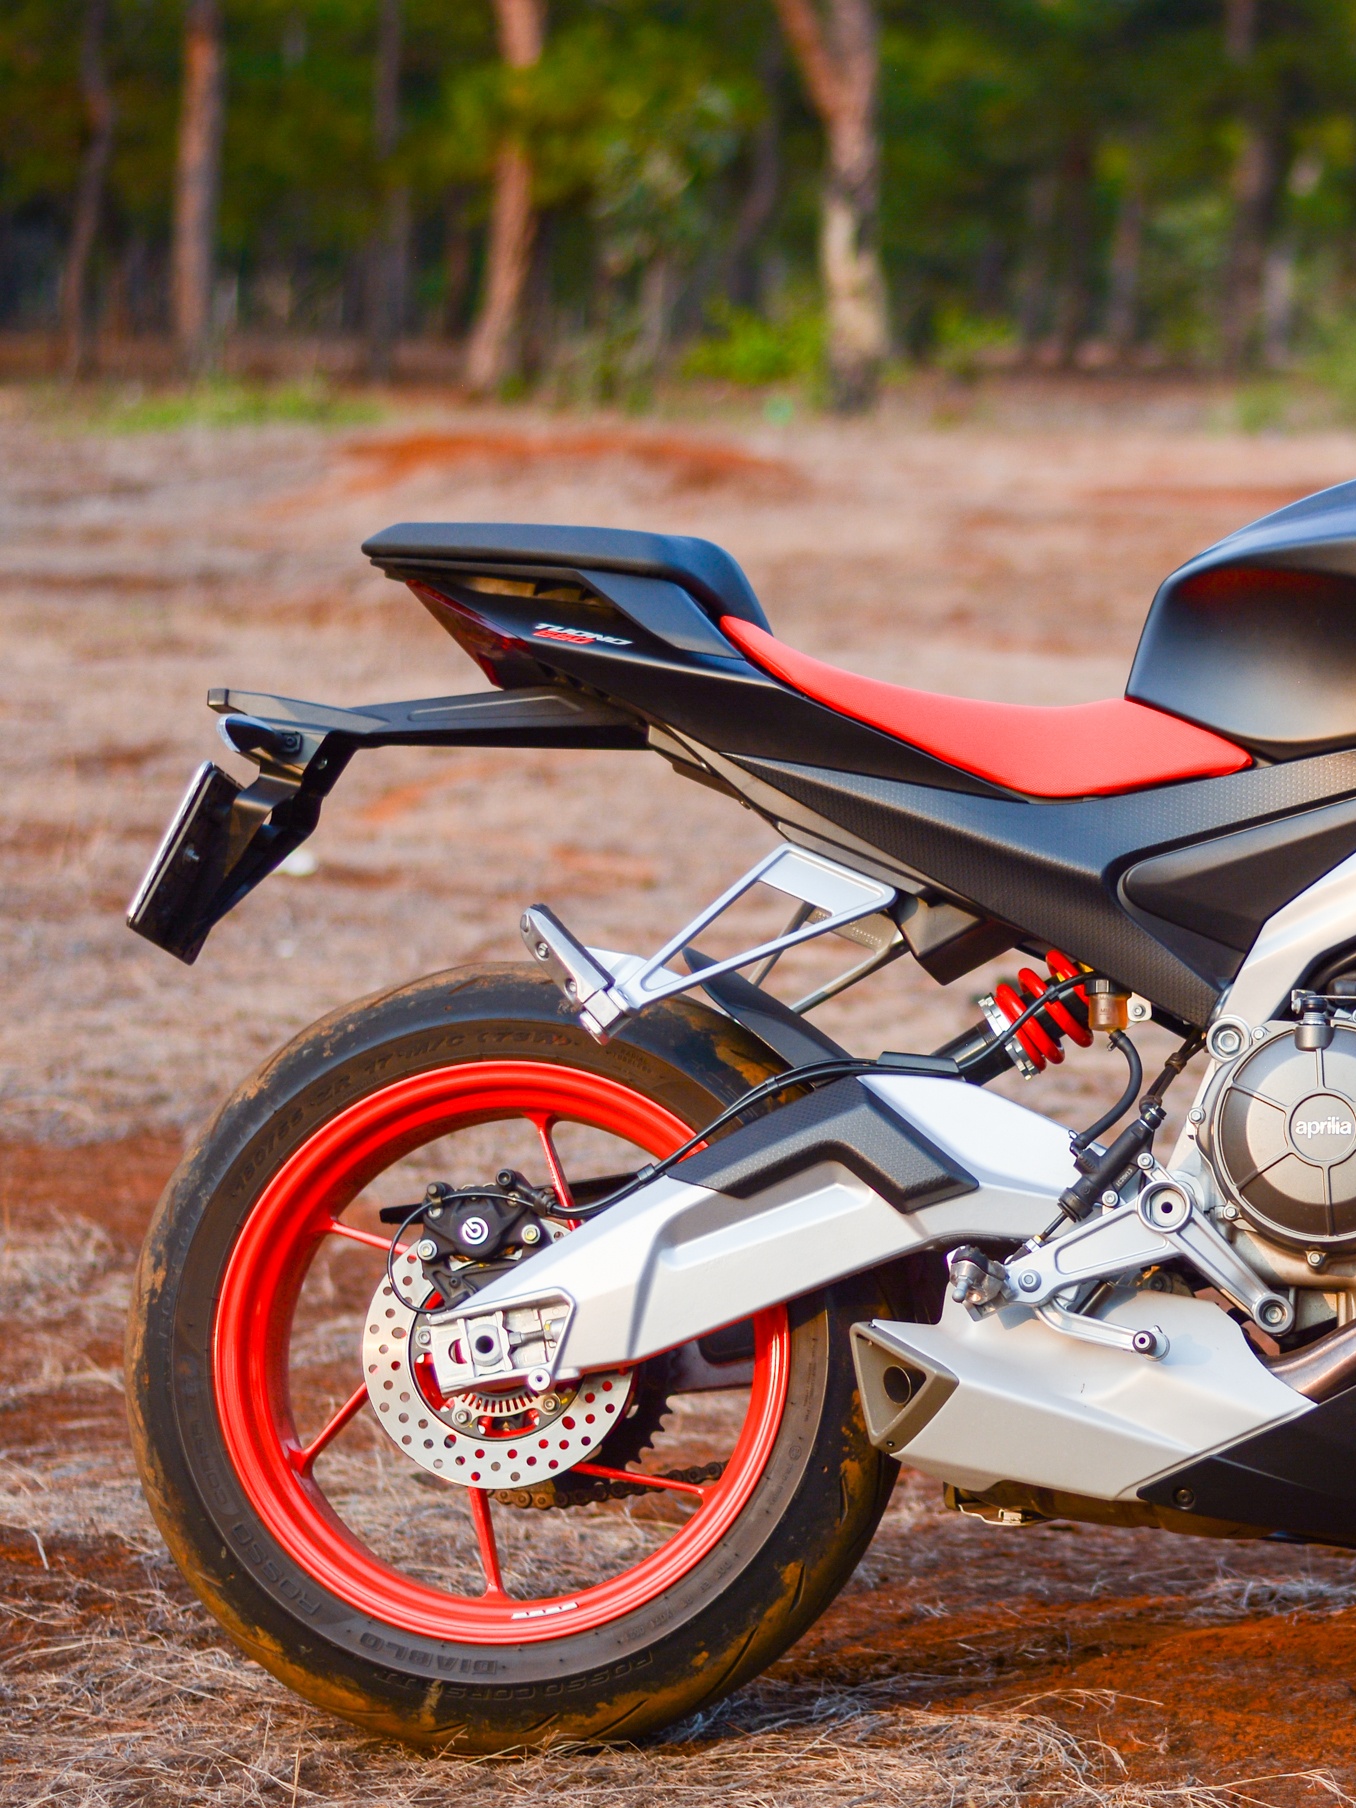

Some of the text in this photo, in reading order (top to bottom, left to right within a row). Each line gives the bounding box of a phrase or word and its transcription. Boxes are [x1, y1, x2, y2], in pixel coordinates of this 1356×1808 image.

[533, 629, 596, 644] 660
[534, 623, 633, 645] TUONO
[1295, 1116, 1352, 1139] aprilia
[227, 1519, 322, 1618] ROSSO
[358, 1628, 497, 1676] DIABLO
[542, 1649, 657, 1696] ROSSO
[422, 1679, 536, 1701] CORSA
